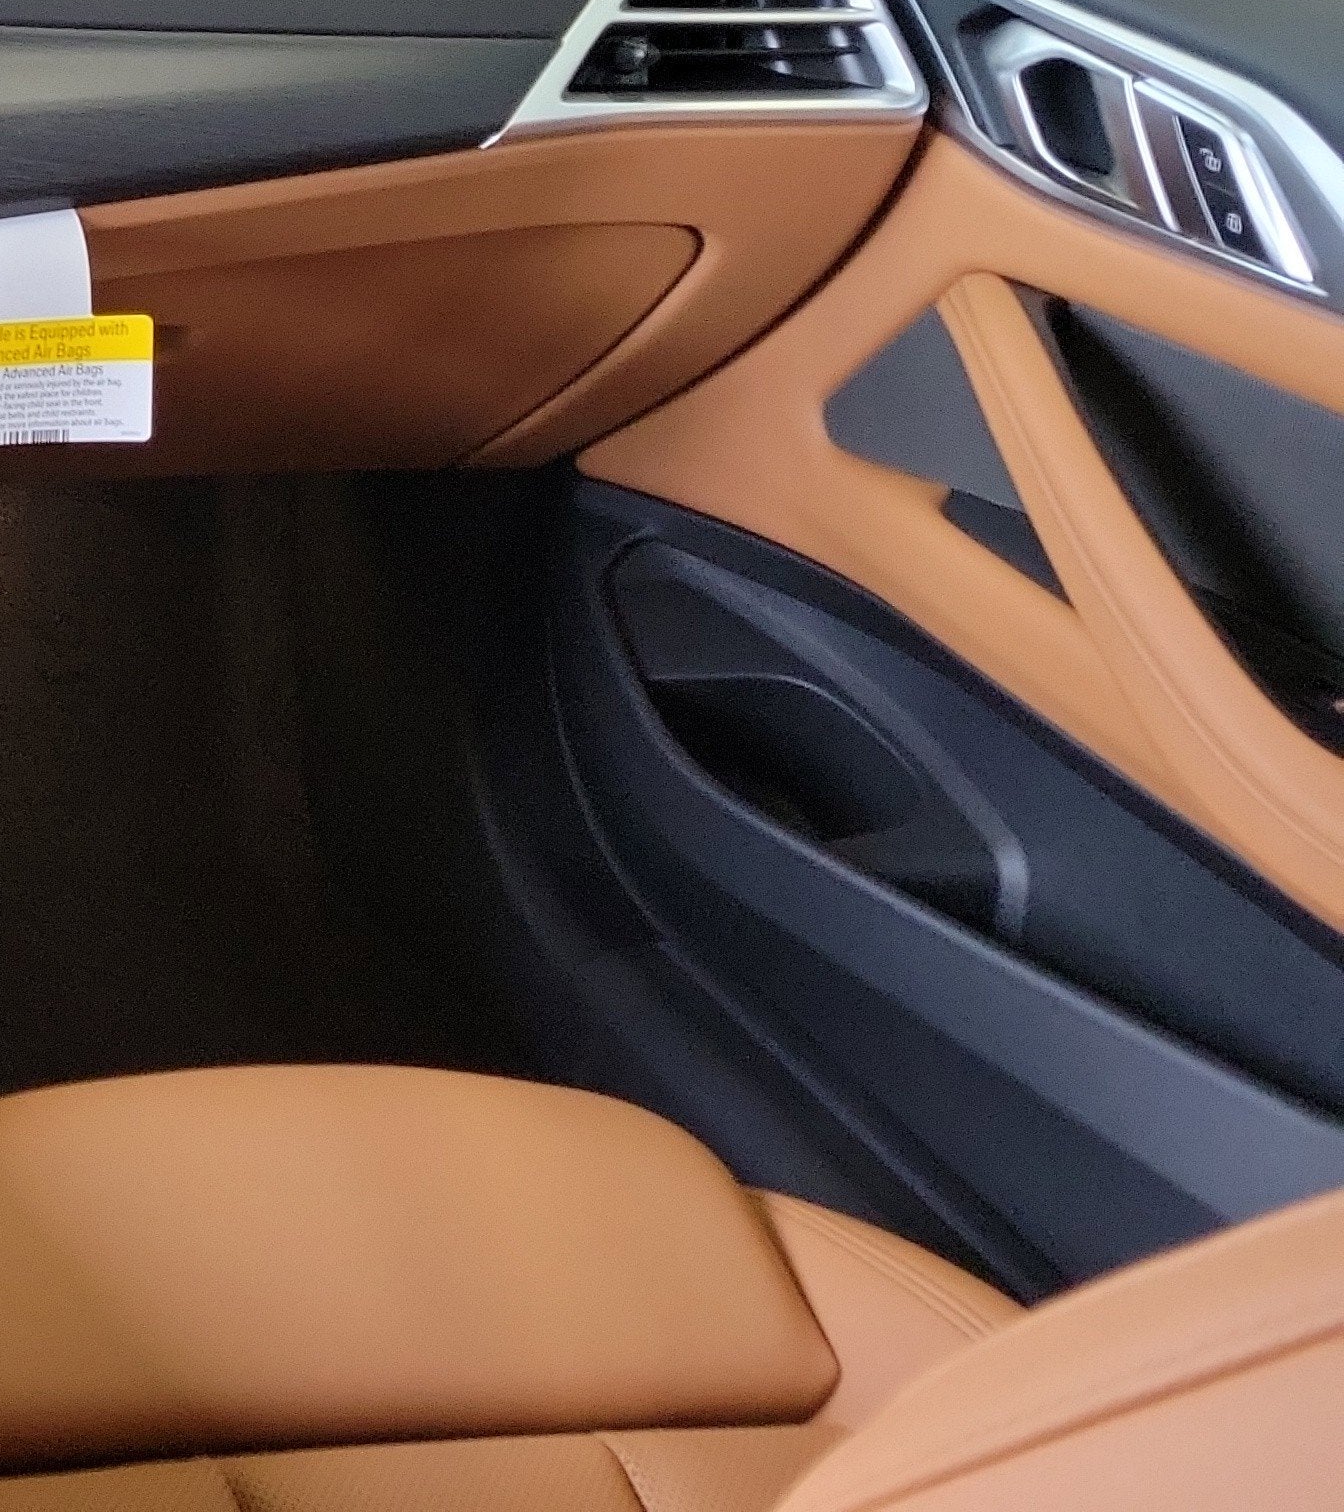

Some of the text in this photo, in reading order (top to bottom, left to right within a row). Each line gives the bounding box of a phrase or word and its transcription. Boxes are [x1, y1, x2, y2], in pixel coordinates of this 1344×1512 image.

[14, 325, 26, 340] is
[29, 321, 96, 343] Equipped
[99, 321, 130, 338] with
[34, 344, 52, 359] Air
[56, 341, 91, 361] Bags
[3, 364, 56, 380] Advanced
[59, 363, 72, 376] Air
[75, 362, 104, 378] Bags
